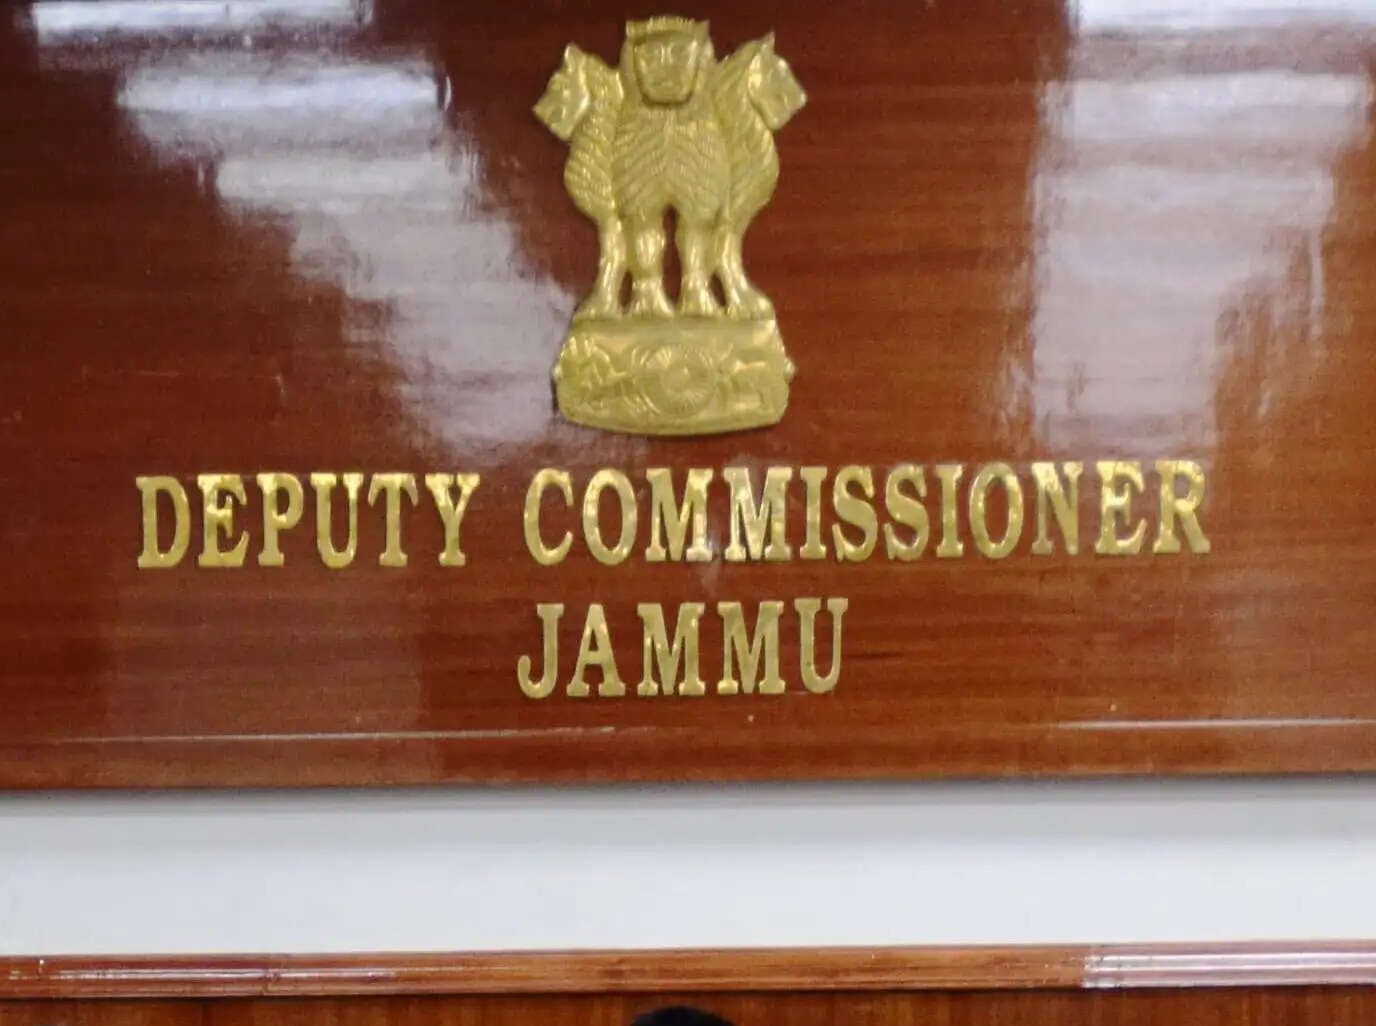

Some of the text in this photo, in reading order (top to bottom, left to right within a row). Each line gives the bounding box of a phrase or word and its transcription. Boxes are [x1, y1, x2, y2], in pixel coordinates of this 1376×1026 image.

[135, 459, 1211, 569] DEPUTY COMMISSIONER
[517, 597, 849, 699] JAMMU
